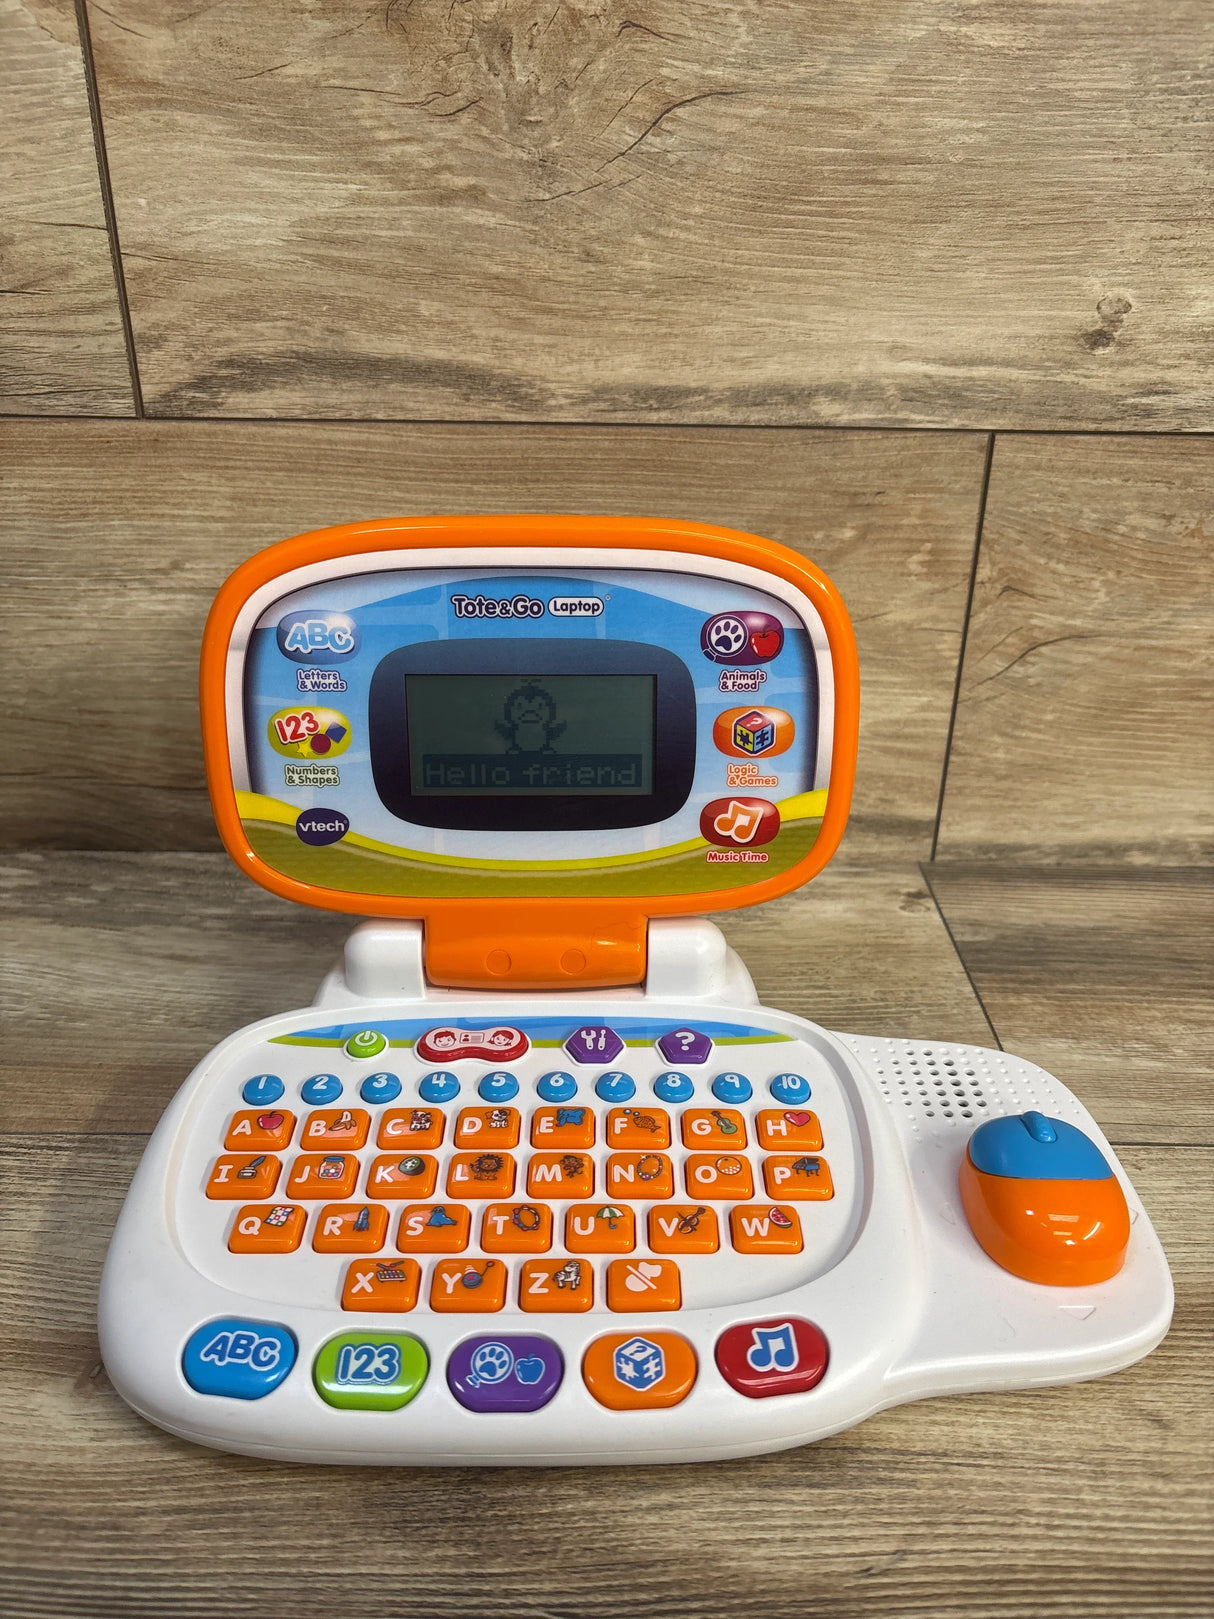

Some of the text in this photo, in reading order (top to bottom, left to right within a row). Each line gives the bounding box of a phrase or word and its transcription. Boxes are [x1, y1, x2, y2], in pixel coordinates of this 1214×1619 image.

[452, 595, 600, 619] Tote&Go Laptop
[285, 620, 355, 654] ABC
[297, 670, 340, 681] Letters
[720, 671, 767, 682] Animals
[297, 680, 347, 691] & Words
[720, 680, 758, 691] & Food
[274, 711, 320, 744] 123
[286, 765, 338, 776] Numbers
[425, 762, 637, 785] Hello friend
[727, 764, 758, 776] Logic
[286, 774, 339, 786] & Shapes
[727, 776, 778, 786] & Games
[299, 819, 345, 832] vtech
[706, 851, 768, 863] Music Time
[259, 1073, 800, 1089] 1 2 3 4 5 6 7 8 9 10
[232, 1117, 787, 1136] A B C D E F G H
[214, 1164, 790, 1184] I J K L M N O P
[238, 1216, 770, 1236] Q R S T U V W
[351, 1272, 549, 1294] X Y Z
[201, 1331, 280, 1371] ABC
[336, 1344, 401, 1384] 123
